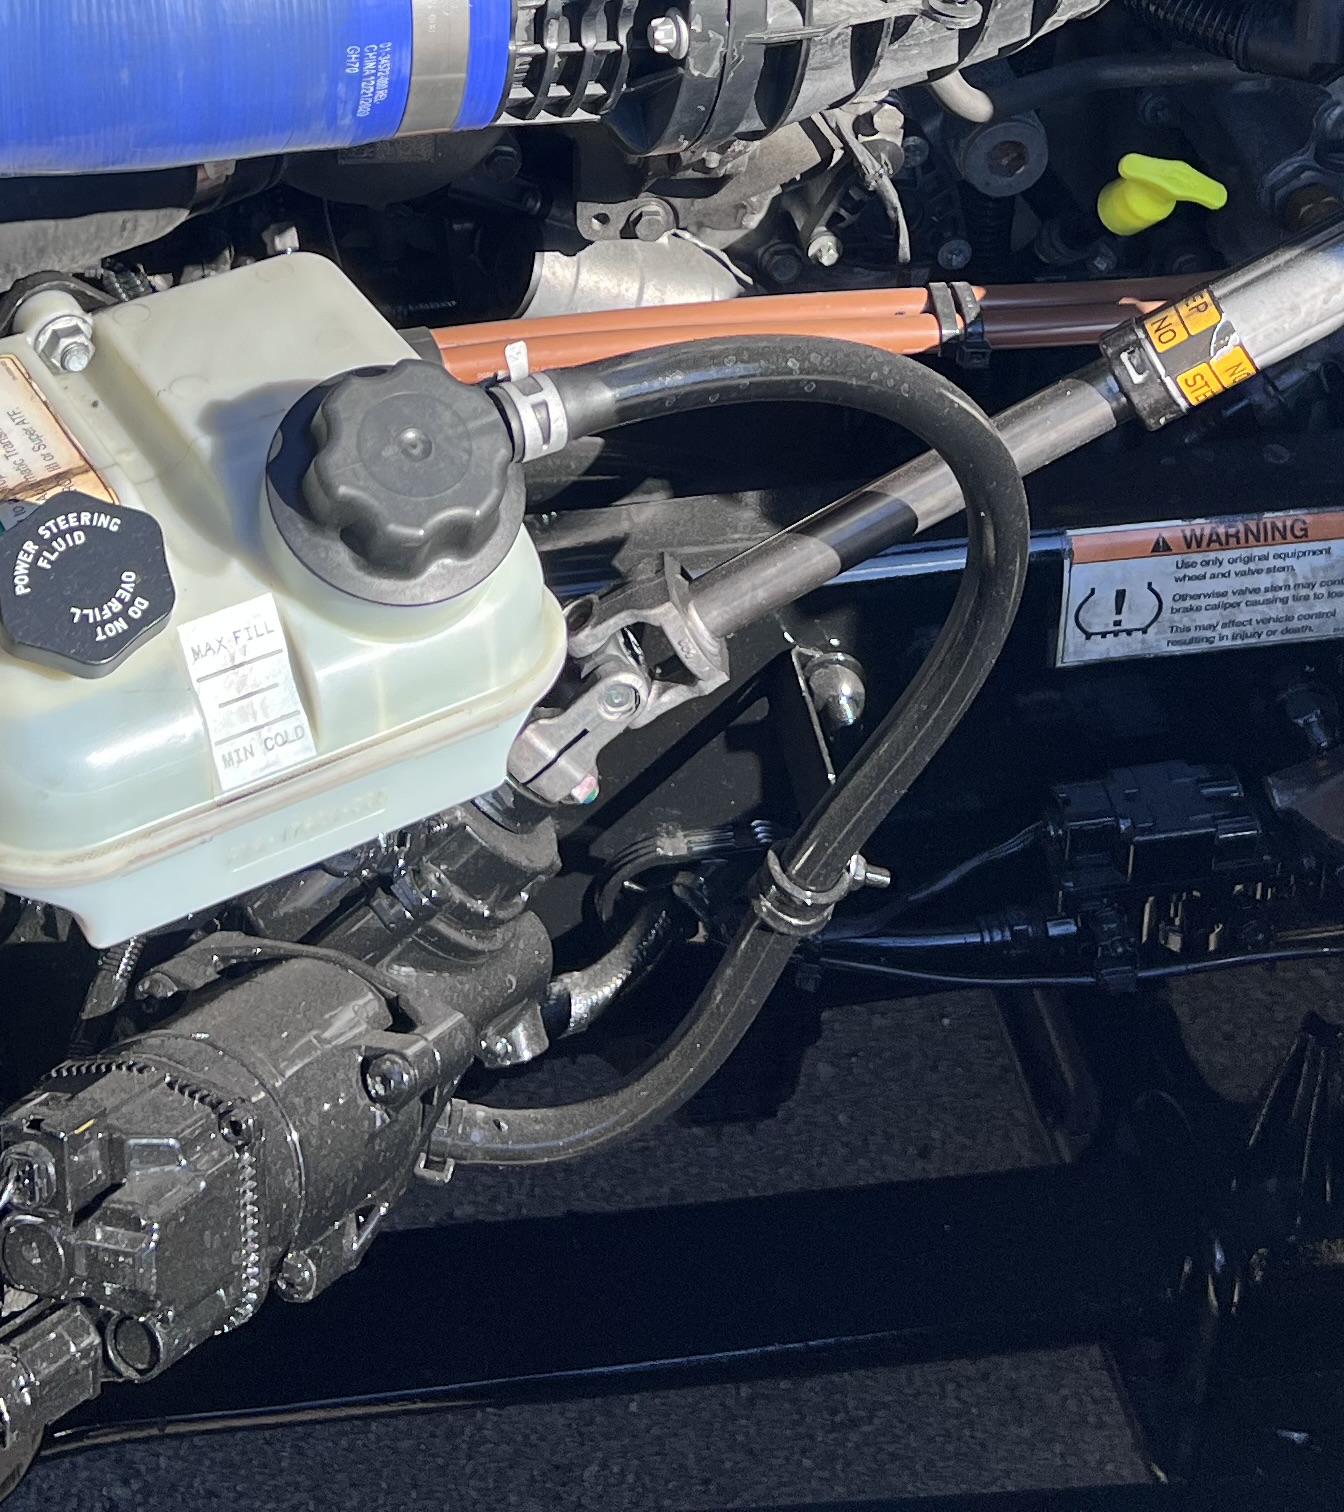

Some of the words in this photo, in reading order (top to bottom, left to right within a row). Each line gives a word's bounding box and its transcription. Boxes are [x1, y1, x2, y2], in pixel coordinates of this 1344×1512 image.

[345, 45, 360, 73] GH70
[363, 45, 377, 76] CHINA
[1151, 315, 1177, 345] NO
[22, 427, 46, 453] Super
[40, 452, 54, 461] or
[1181, 518, 1310, 550] WARNING
[13, 540, 39, 597] POWER
[38, 511, 122, 539] STEERING
[37, 530, 86, 570] FLUID
[1176, 559, 1198, 569] Use
[1200, 557, 1224, 568] only
[1228, 551, 1269, 565] original
[1273, 546, 1331, 561] equipment
[1174, 571, 1207, 582] wheel
[1209, 569, 1231, 579] and
[1234, 567, 1264, 577] valve
[1266, 565, 1295, 574] stem.
[70, 571, 136, 624] OVERFILL
[1170, 604, 1202, 614] brake
[1205, 601, 1242, 611] caliper
[1245, 594, 1289, 607] causing
[1292, 592, 1310, 602] tire
[1313, 592, 1324, 600] to
[1172, 590, 1229, 603] Otherwise
[1231, 587, 1261, 596] valve
[1264, 582, 1290, 593] stem
[1293, 581, 1317, 591] may
[128, 596, 150, 619] DO
[95, 617, 129, 641] NOT
[1169, 625, 1191, 634] This
[1195, 620, 1220, 632] may
[1221, 618, 1253, 629] affect
[1255, 614, 1295, 625] vehicle
[1297, 608, 1336, 621] control
[191, 637, 227, 663] MAX
[232, 621, 275, 645] FILL
[1167, 635, 1215, 647] resulting
[1218, 633, 1229, 642] in
[1231, 630, 1263, 641] injury
[1266, 629, 1279, 637] or
[1281, 625, 1313, 635] death.
[222, 744, 255, 769] MIN
[264, 725, 305, 752] COLD
